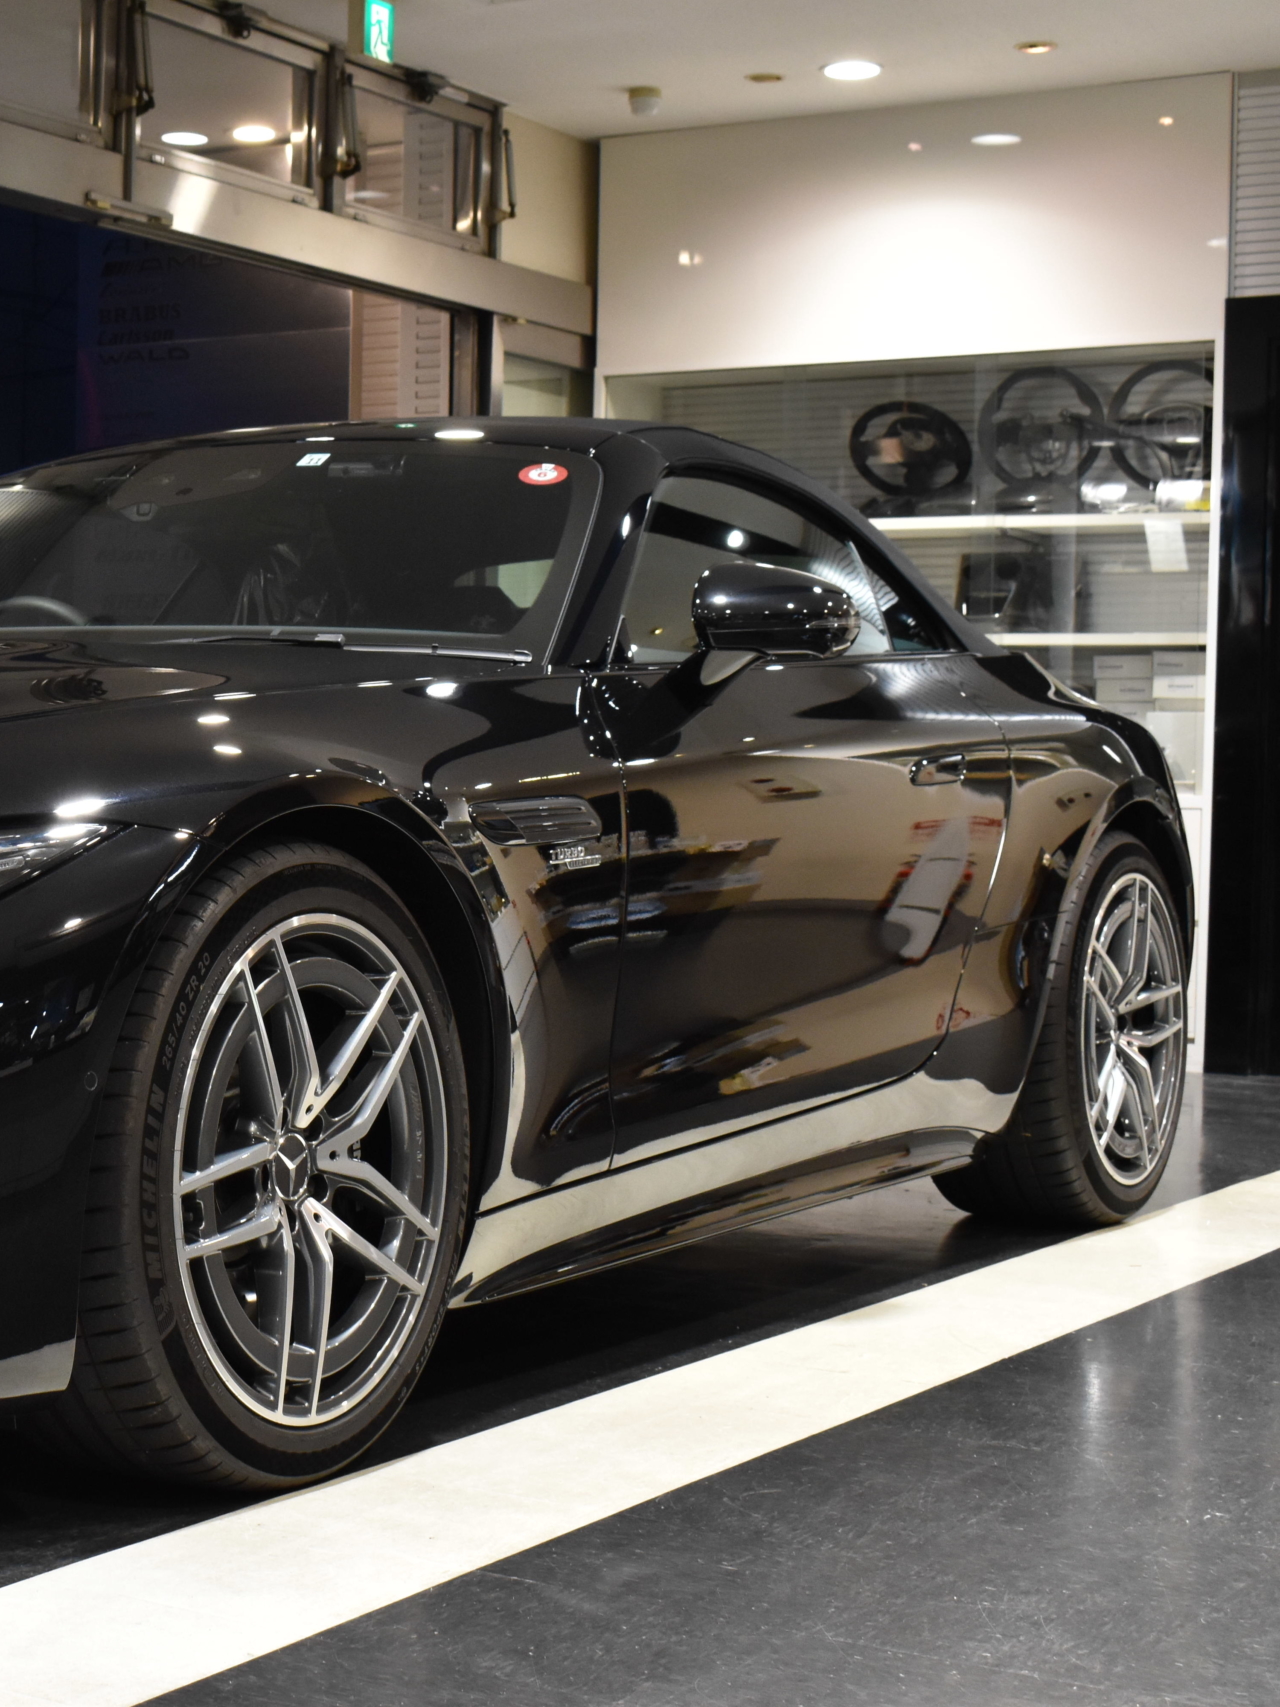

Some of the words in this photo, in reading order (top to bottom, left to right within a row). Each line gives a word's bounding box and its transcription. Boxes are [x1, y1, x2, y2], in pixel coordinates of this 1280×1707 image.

[98, 303, 182, 325] BRABUS
[99, 347, 190, 365] WALD
[550, 846, 585, 860] TURBO
[161, 1001, 187, 1071] 265/40
[184, 974, 199, 1001] ZR
[197, 952, 211, 975] 20
[142, 1082, 167, 1280] MICHELIN
